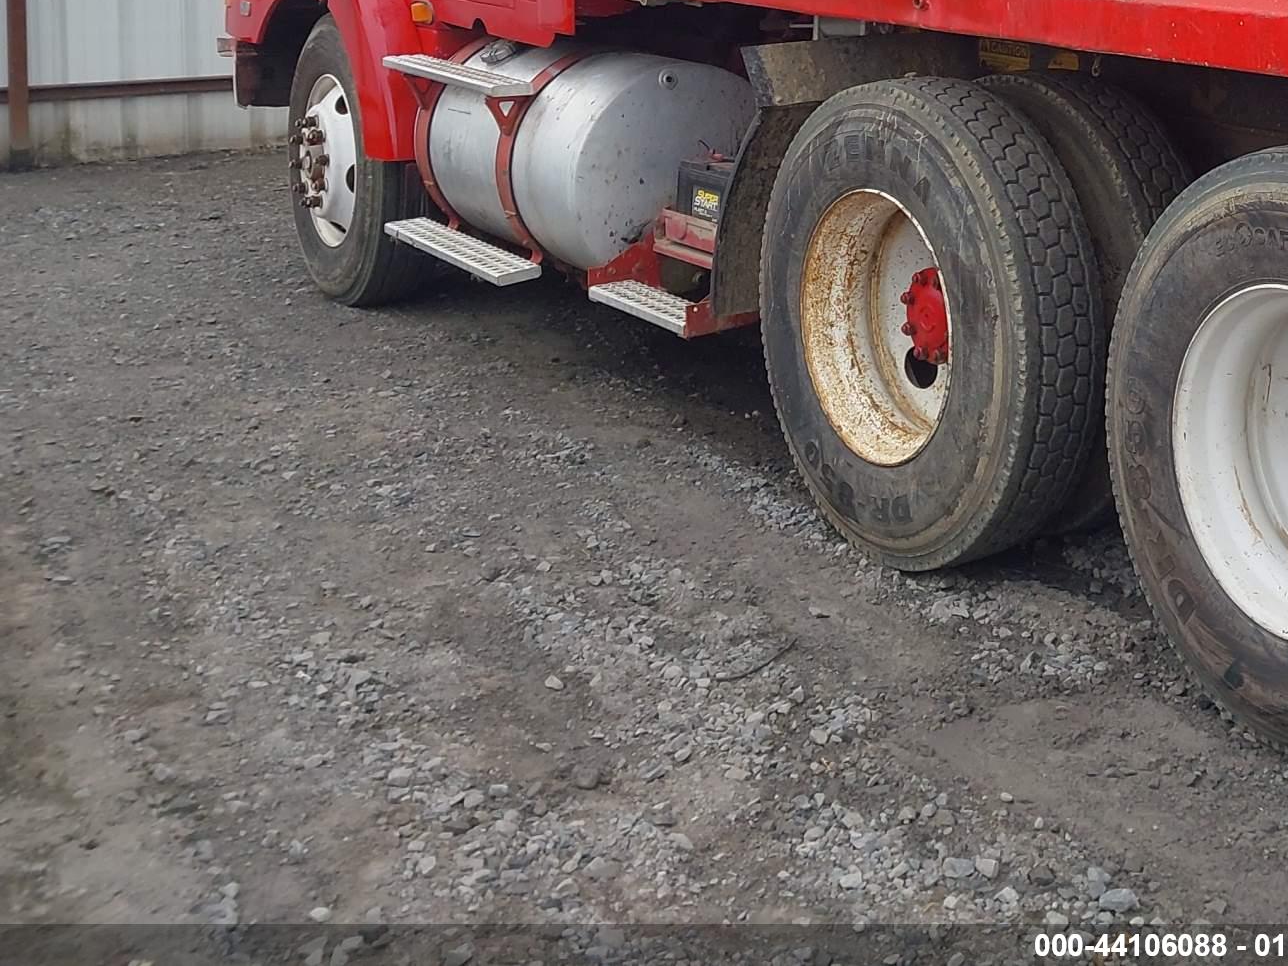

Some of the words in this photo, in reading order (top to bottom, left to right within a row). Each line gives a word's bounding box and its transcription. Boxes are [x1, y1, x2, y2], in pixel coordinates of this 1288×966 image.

[991, 41, 1027, 58] CAUTION
[693, 195, 719, 212] START
[697, 189, 719, 202] SUPER
